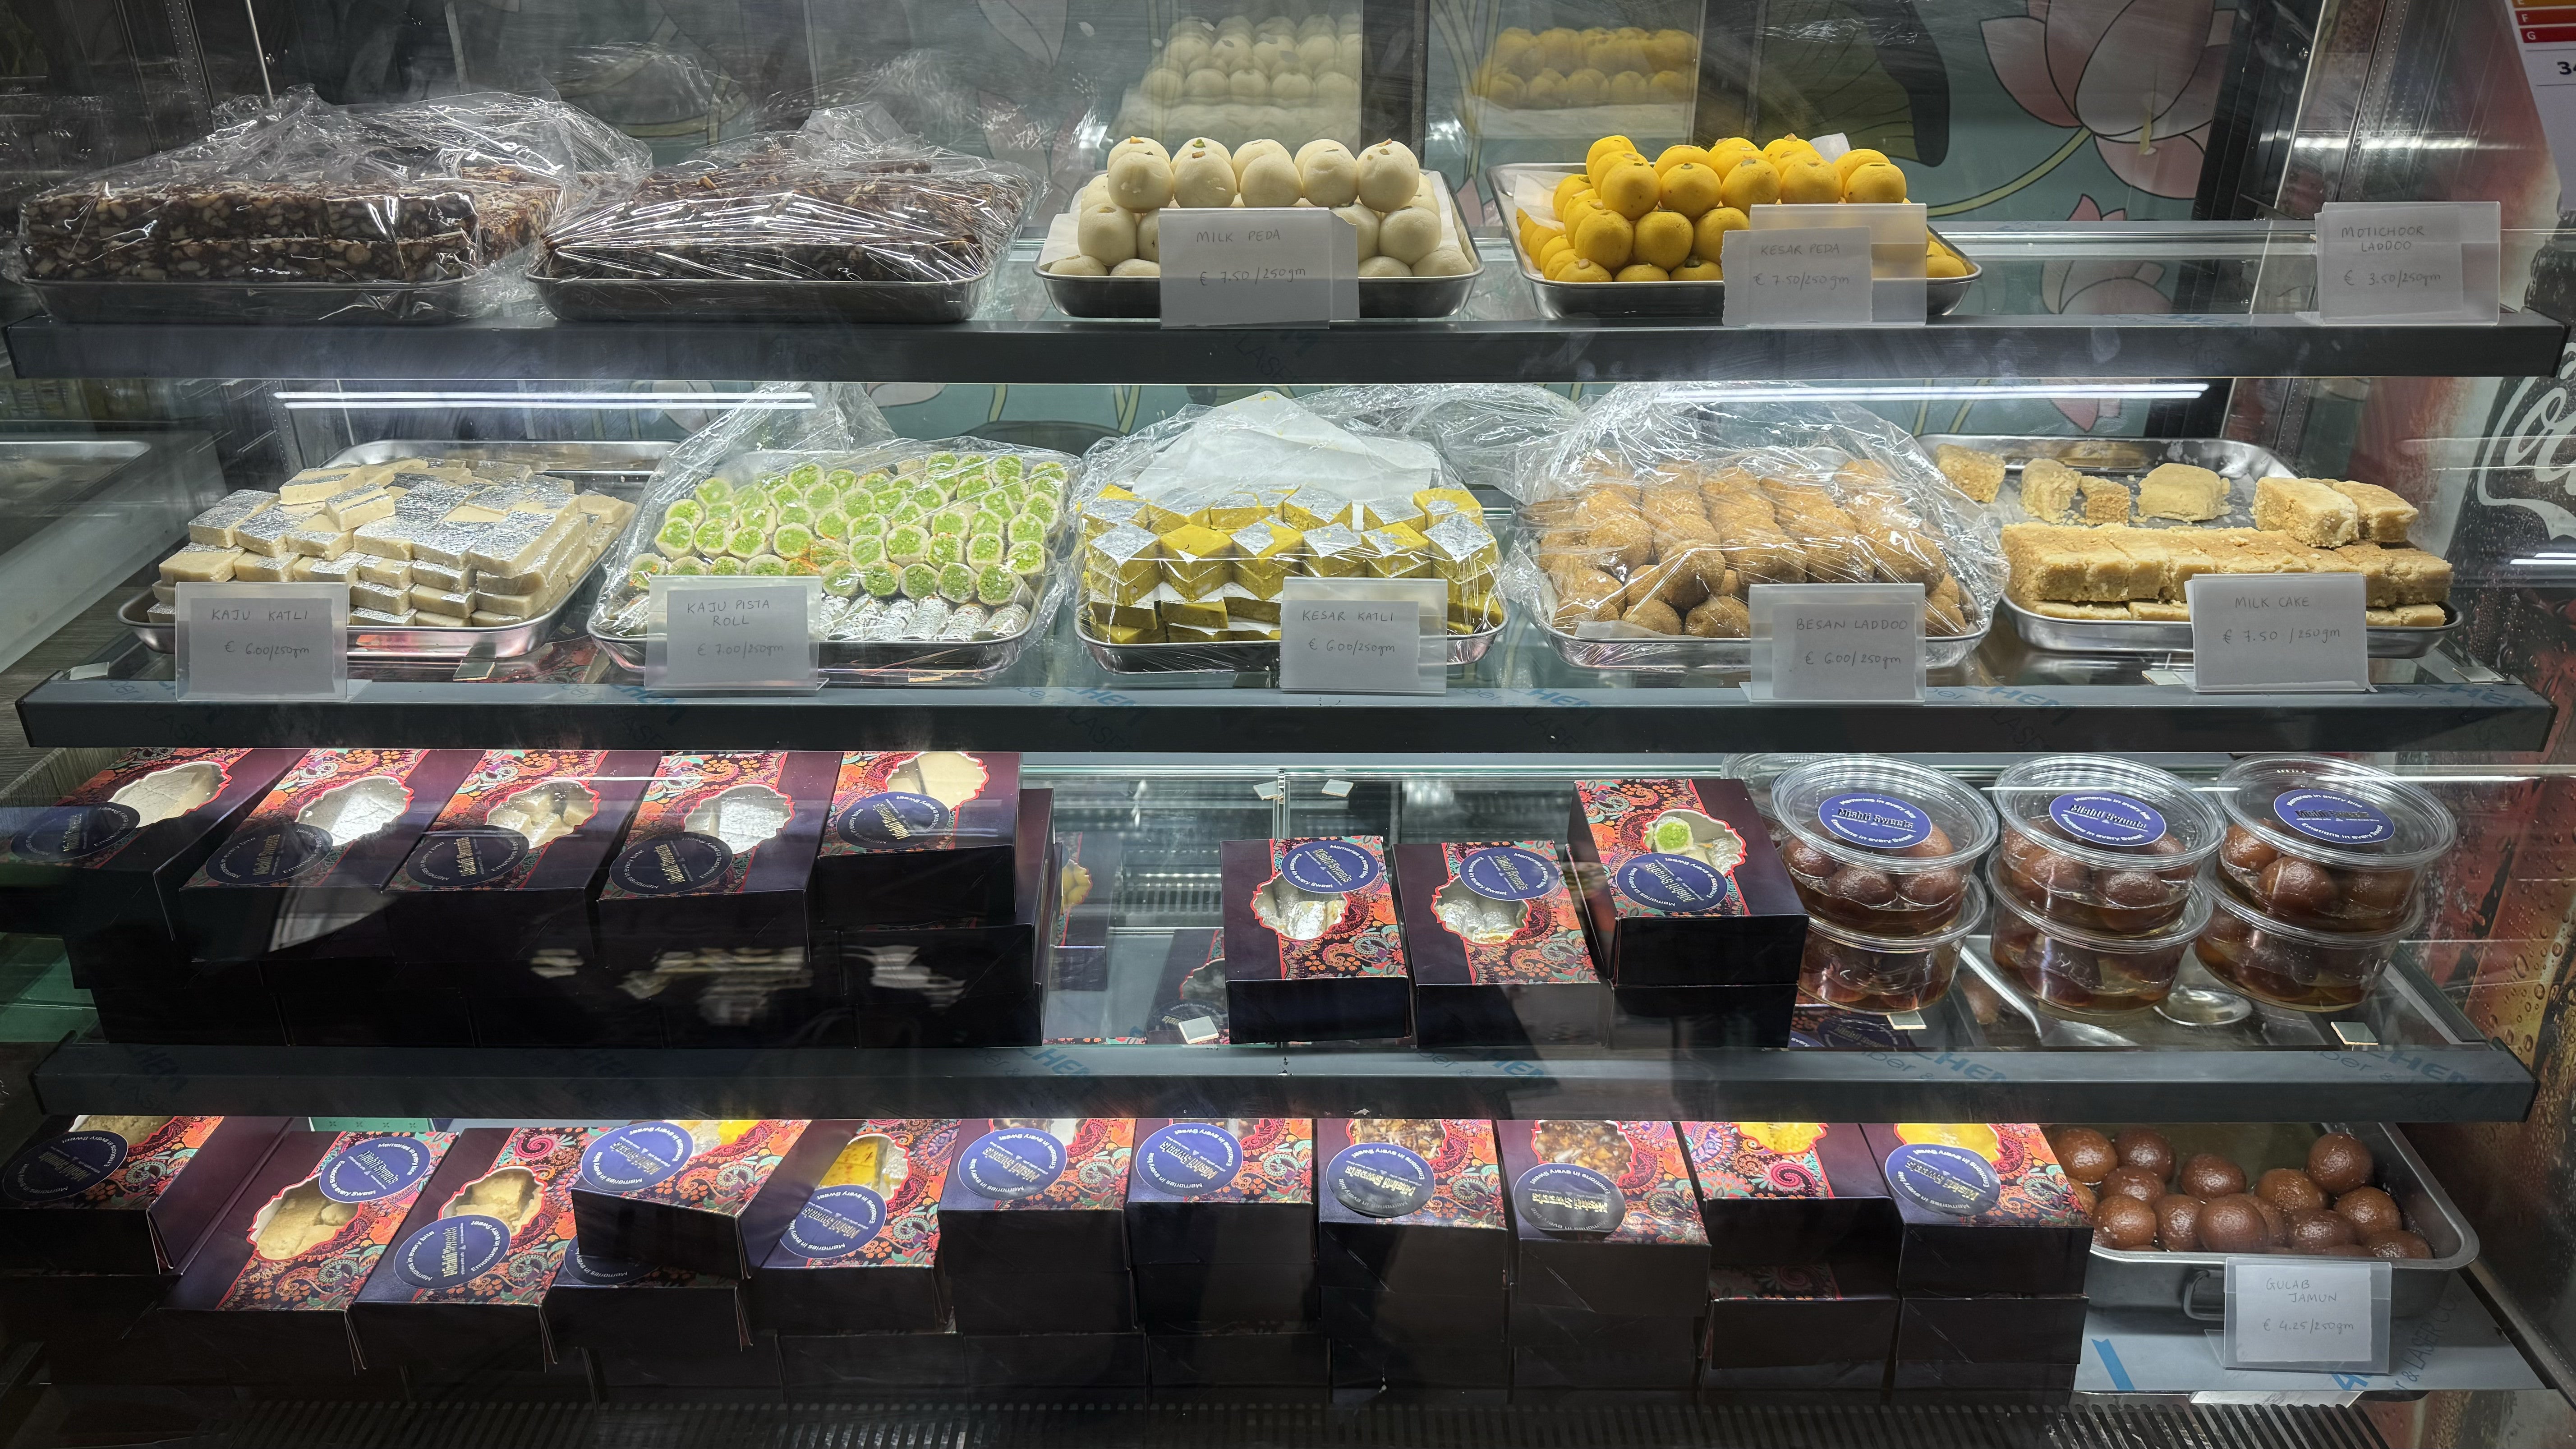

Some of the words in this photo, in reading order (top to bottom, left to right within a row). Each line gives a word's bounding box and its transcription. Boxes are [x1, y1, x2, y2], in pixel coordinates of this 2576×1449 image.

[2521, 14, 2528, 22] F
[2527, 32, 2536, 40] G
[1196, 231, 1233, 243] MILK
[1248, 229, 1281, 241] PEDA
[2342, 225, 2424, 238] MOTICHOOR
[1761, 244, 1802, 255] KESAR
[1809, 243, 1839, 254] PEDA
[2361, 241, 2412, 252] LADDOO
[1200, 271, 1208, 285] €
[687, 601, 727, 614] KAJU
[736, 599, 769, 610] PISTA
[2235, 597, 2269, 608] MILK
[2278, 597, 2309, 607] CAKE
[212, 608, 250, 620] KAJU
[269, 610, 308, 621] KATLI
[1302, 609, 1345, 621] KESAR
[1358, 612, 1393, 621] KATLI
[713, 616, 750, 626] ROLL
[1797, 618, 1845, 630] BESAN
[1854, 620, 1908, 630] LADDOO
[2223, 630, 2232, 644] €
[225, 640, 235, 653] €
[697, 643, 707, 656] €
[1309, 638, 1317, 650] €
[1805, 651, 1814, 664] €
[2266, 1278, 2310, 1290] GULAB
[2288, 1292, 2337, 1303] JAMUN
[2263, 1318, 2271, 1331] €
